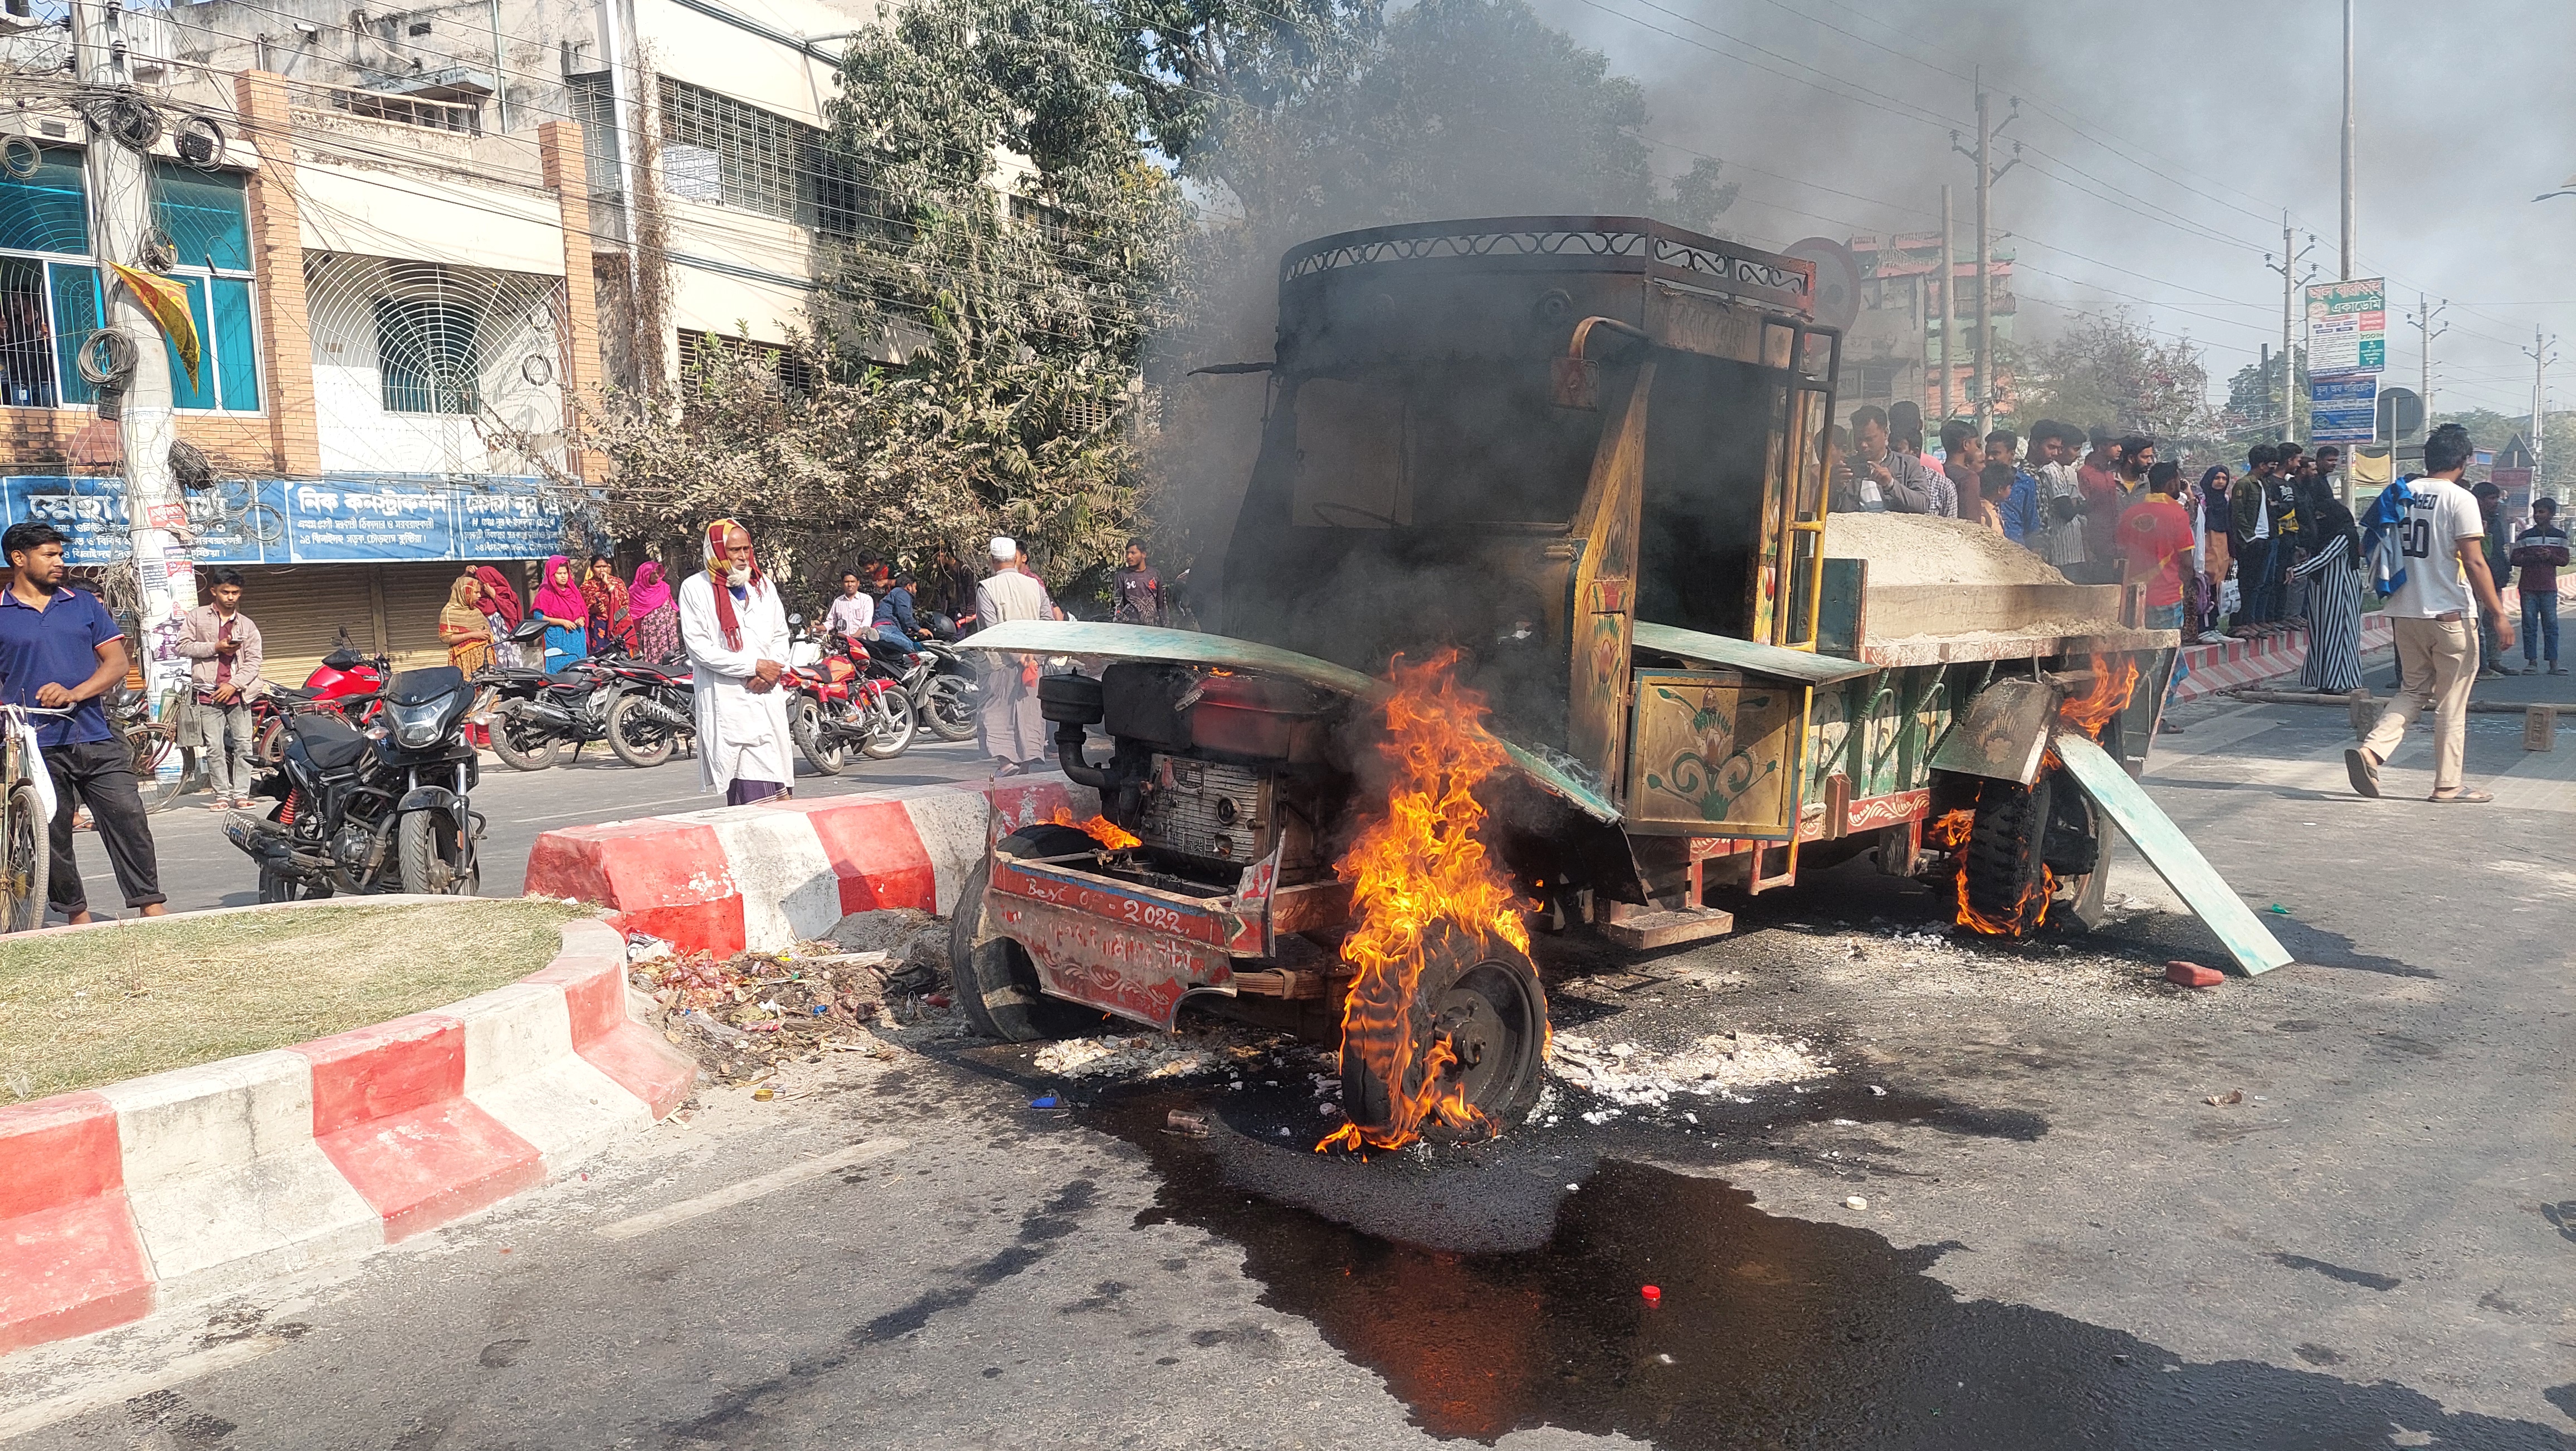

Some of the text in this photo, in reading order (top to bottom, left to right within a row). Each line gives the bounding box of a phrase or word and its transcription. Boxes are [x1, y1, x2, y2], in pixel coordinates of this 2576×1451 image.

[2307, 285, 2334, 300] আল
[2331, 296, 2383, 313] একাডেমি
[297, 486, 339, 514] নিক
[2413, 493, 2438, 510] AHED
[359, 517, 386, 529] ঠিকাদার
[387, 520, 393, 529] ও
[395, 517, 435, 529] সরবরাহকারী
[300, 535, 310, 544] ১৪
